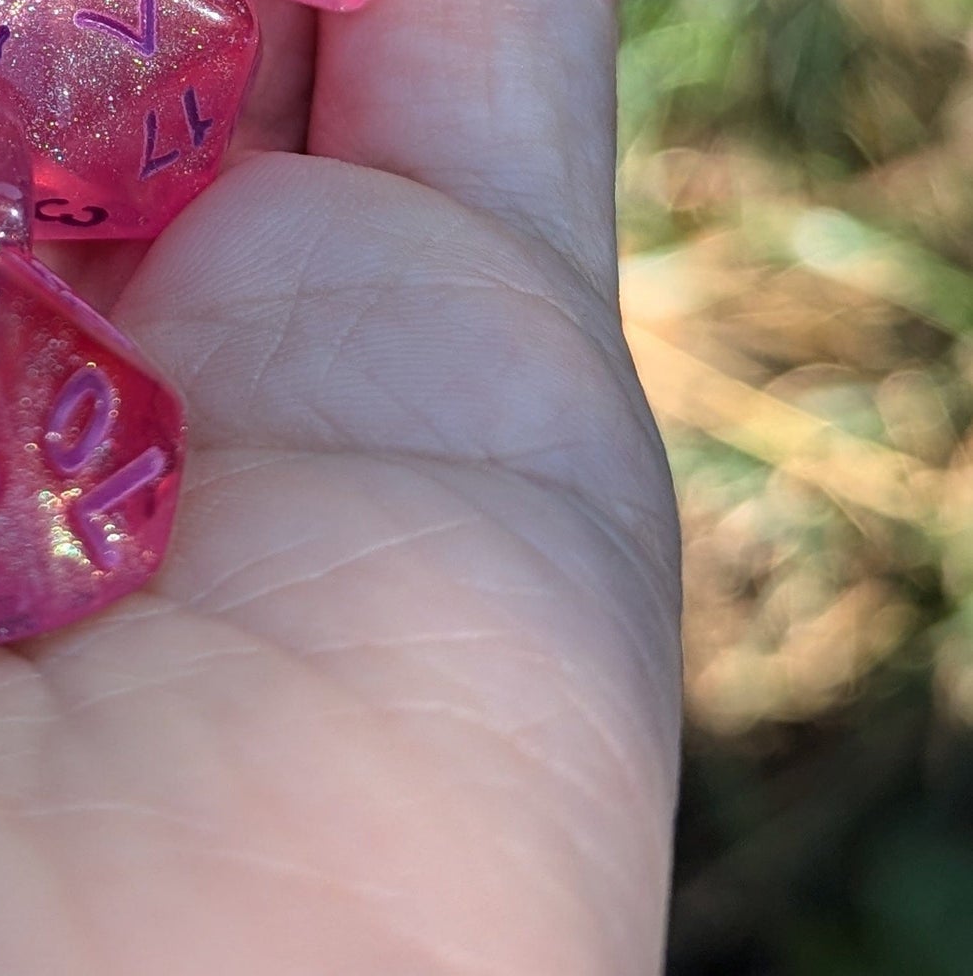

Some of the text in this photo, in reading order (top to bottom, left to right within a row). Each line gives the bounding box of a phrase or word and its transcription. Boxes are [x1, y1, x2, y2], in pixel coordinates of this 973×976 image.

[139, 86, 214, 180] 17
[33, 198, 110, 227] 3
[44, 366, 167, 569] 70
